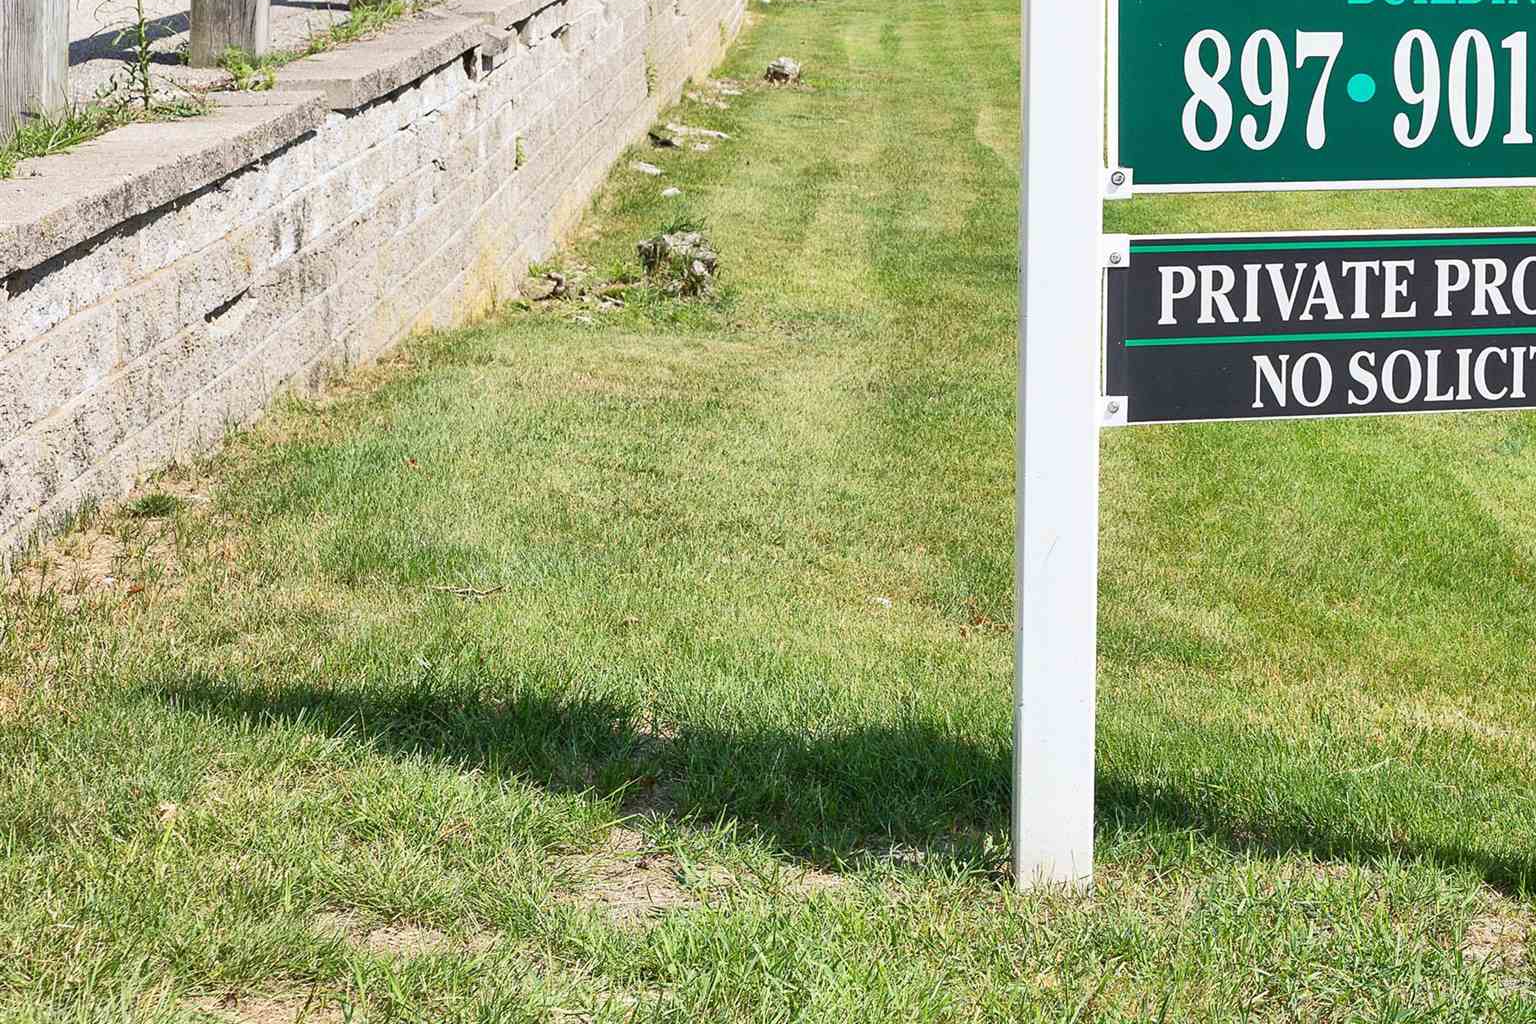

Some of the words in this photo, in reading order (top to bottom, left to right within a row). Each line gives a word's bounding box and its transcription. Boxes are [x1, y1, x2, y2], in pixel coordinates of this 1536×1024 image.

[1181, 29, 1344, 151] 897
[1393, 28, 1533, 149] 901
[1157, 259, 1417, 325] PRIVATE
[1251, 352, 1333, 409] NO
